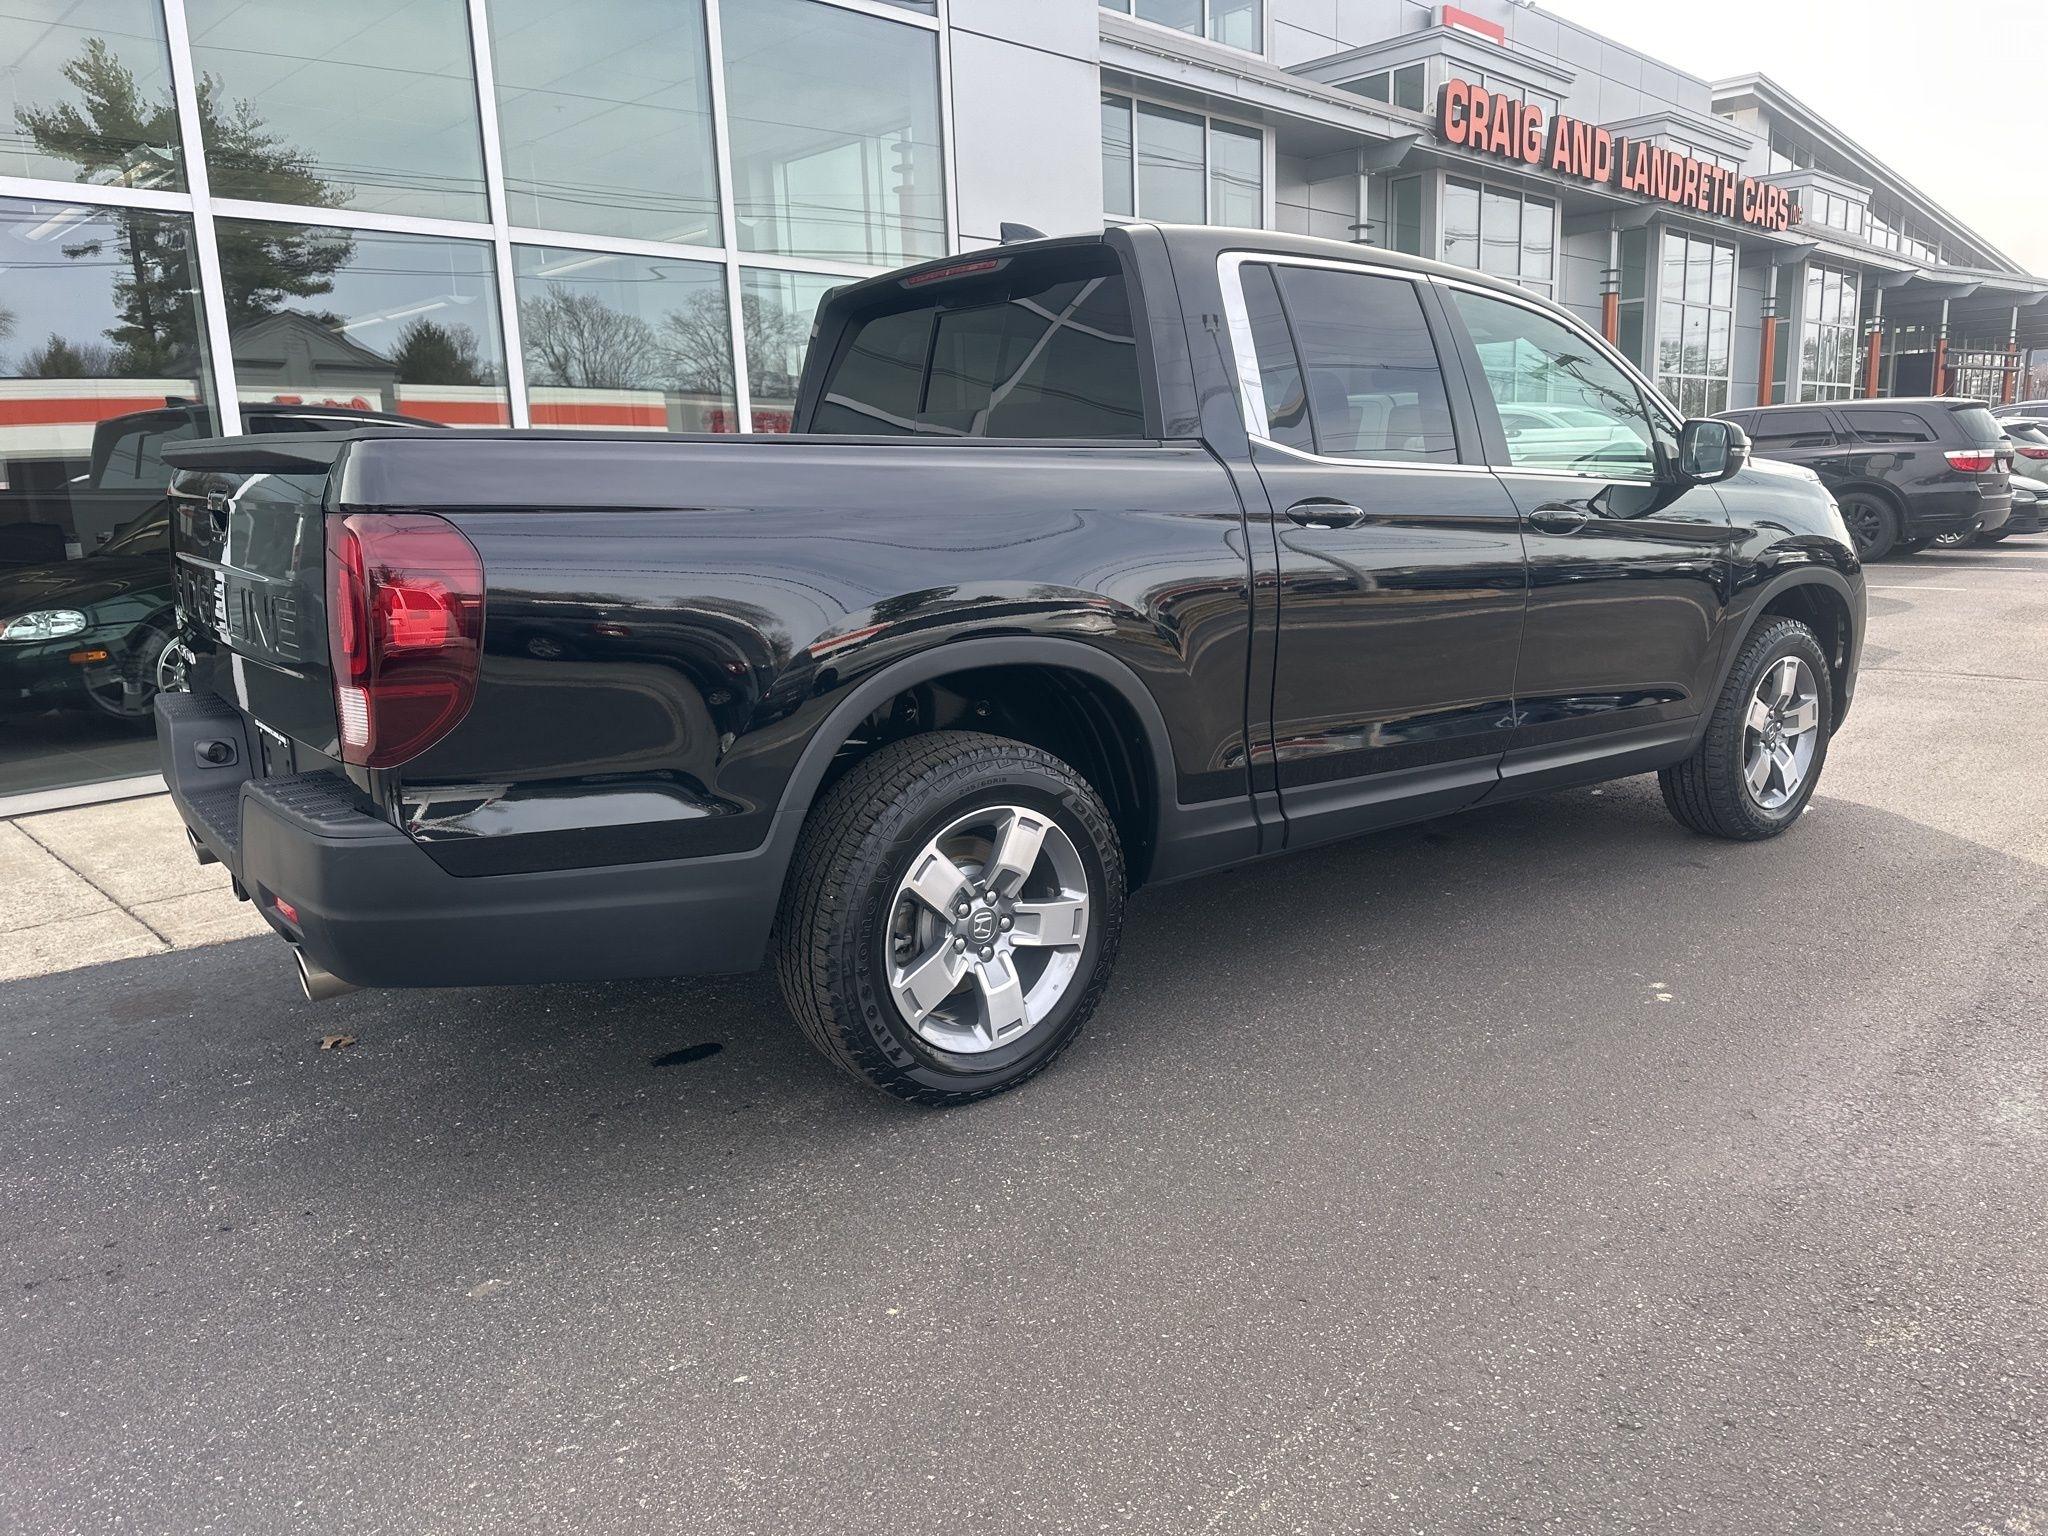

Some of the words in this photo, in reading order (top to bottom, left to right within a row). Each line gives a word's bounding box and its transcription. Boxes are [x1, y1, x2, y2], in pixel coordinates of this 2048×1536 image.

[1443, 78, 1543, 164] CRAIG
[1551, 115, 1611, 183] AND
[1619, 137, 1738, 217] LANDRETH
[1741, 176, 1789, 232] CARS
